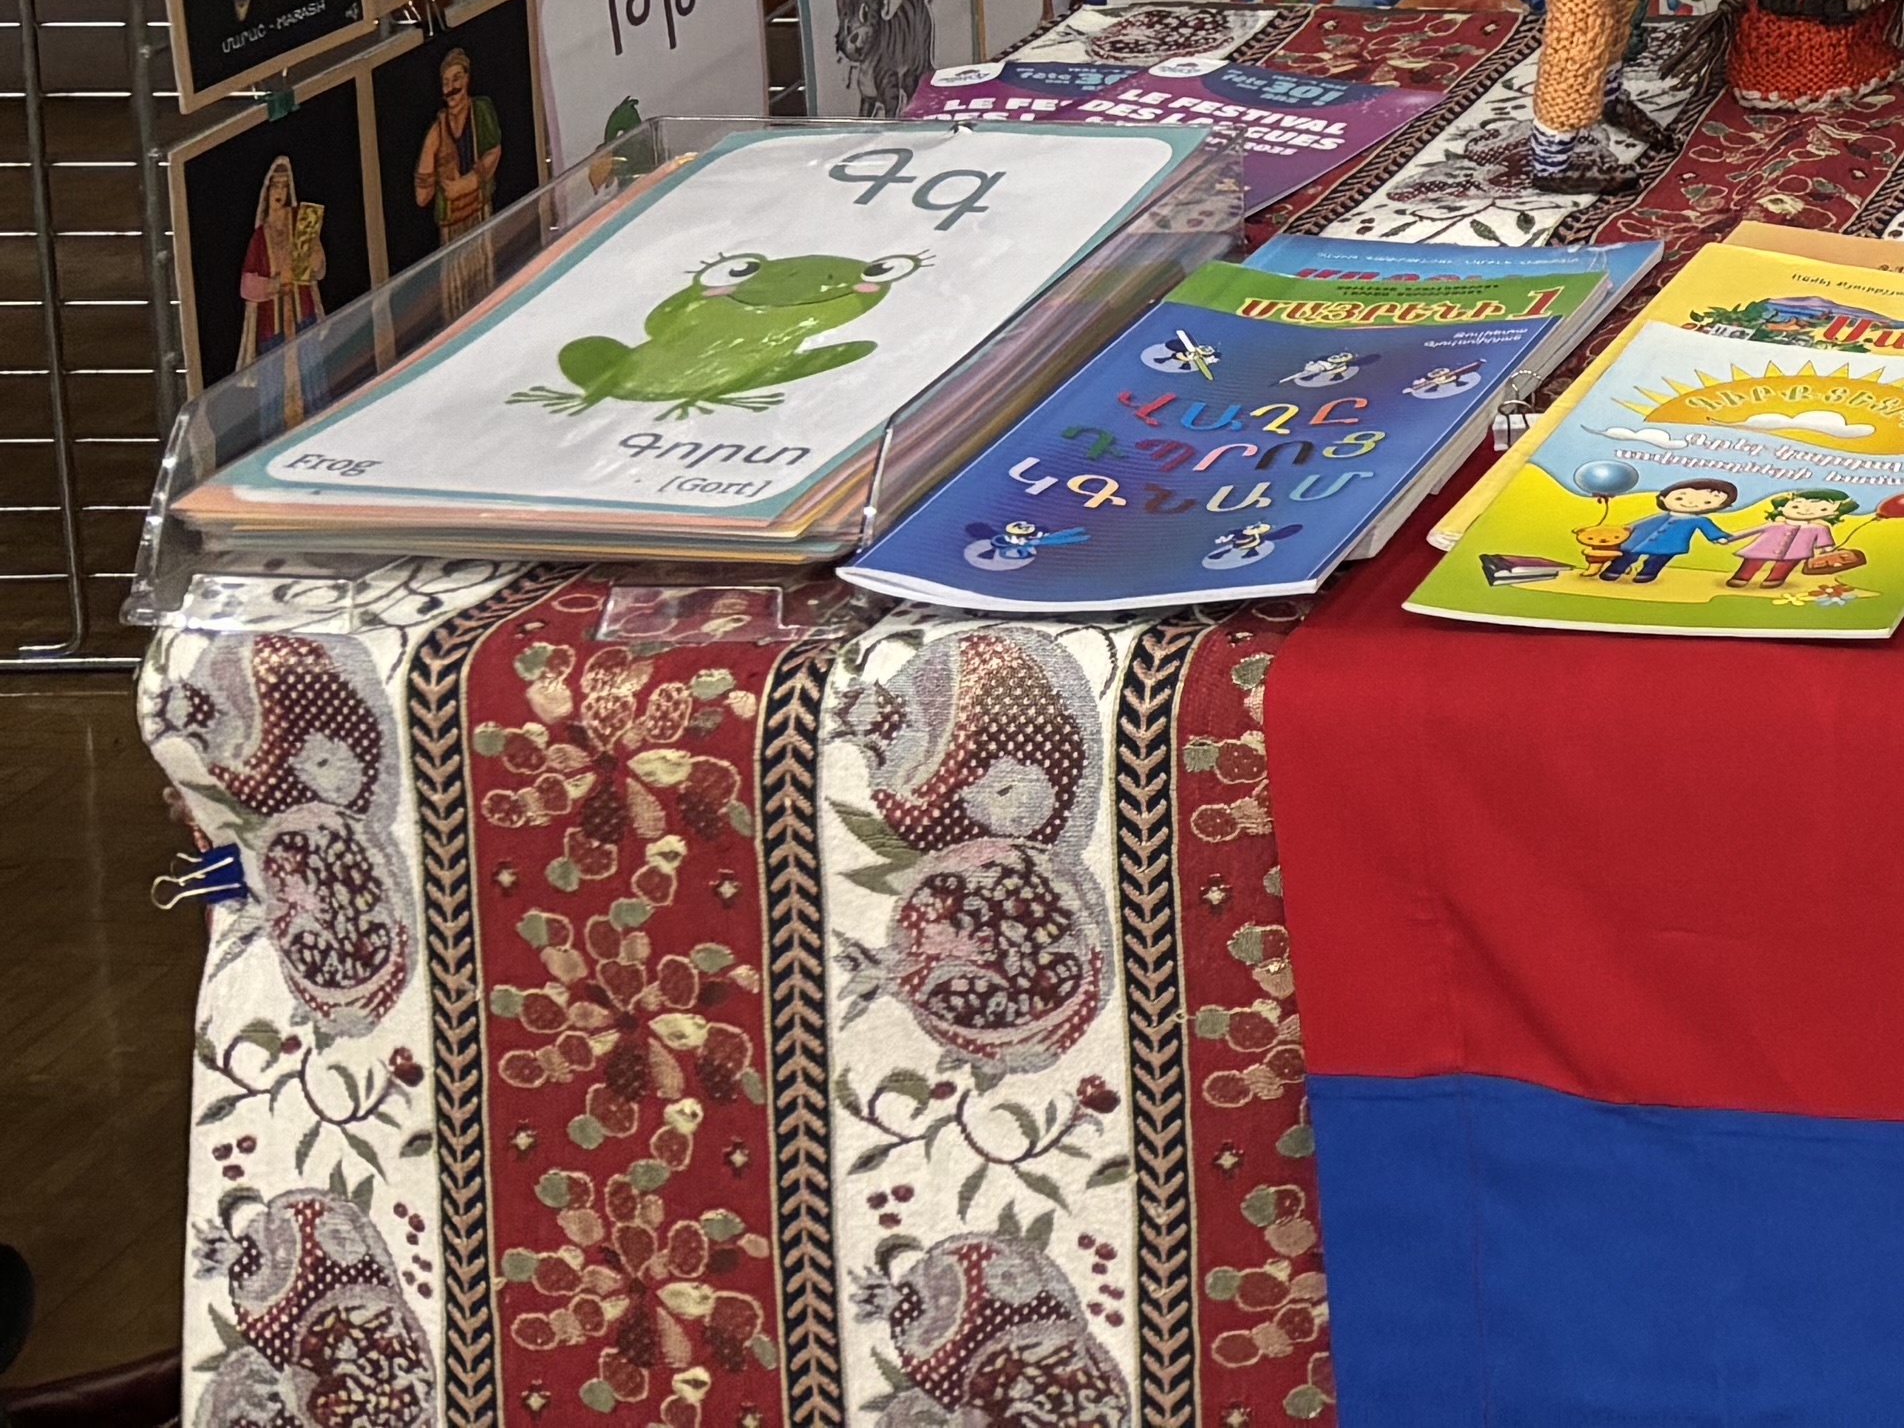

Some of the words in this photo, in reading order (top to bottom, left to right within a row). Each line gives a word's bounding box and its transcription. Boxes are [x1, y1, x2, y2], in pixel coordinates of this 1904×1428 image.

[1078, 99, 1164, 122] DES
[1117, 89, 1173, 105] LE
[1167, 96, 1348, 136] FESTIVAL
[1507, 285, 1567, 321] 1
[288, 451, 384, 478] Frog
[656, 474, 774, 499] [Gort]
